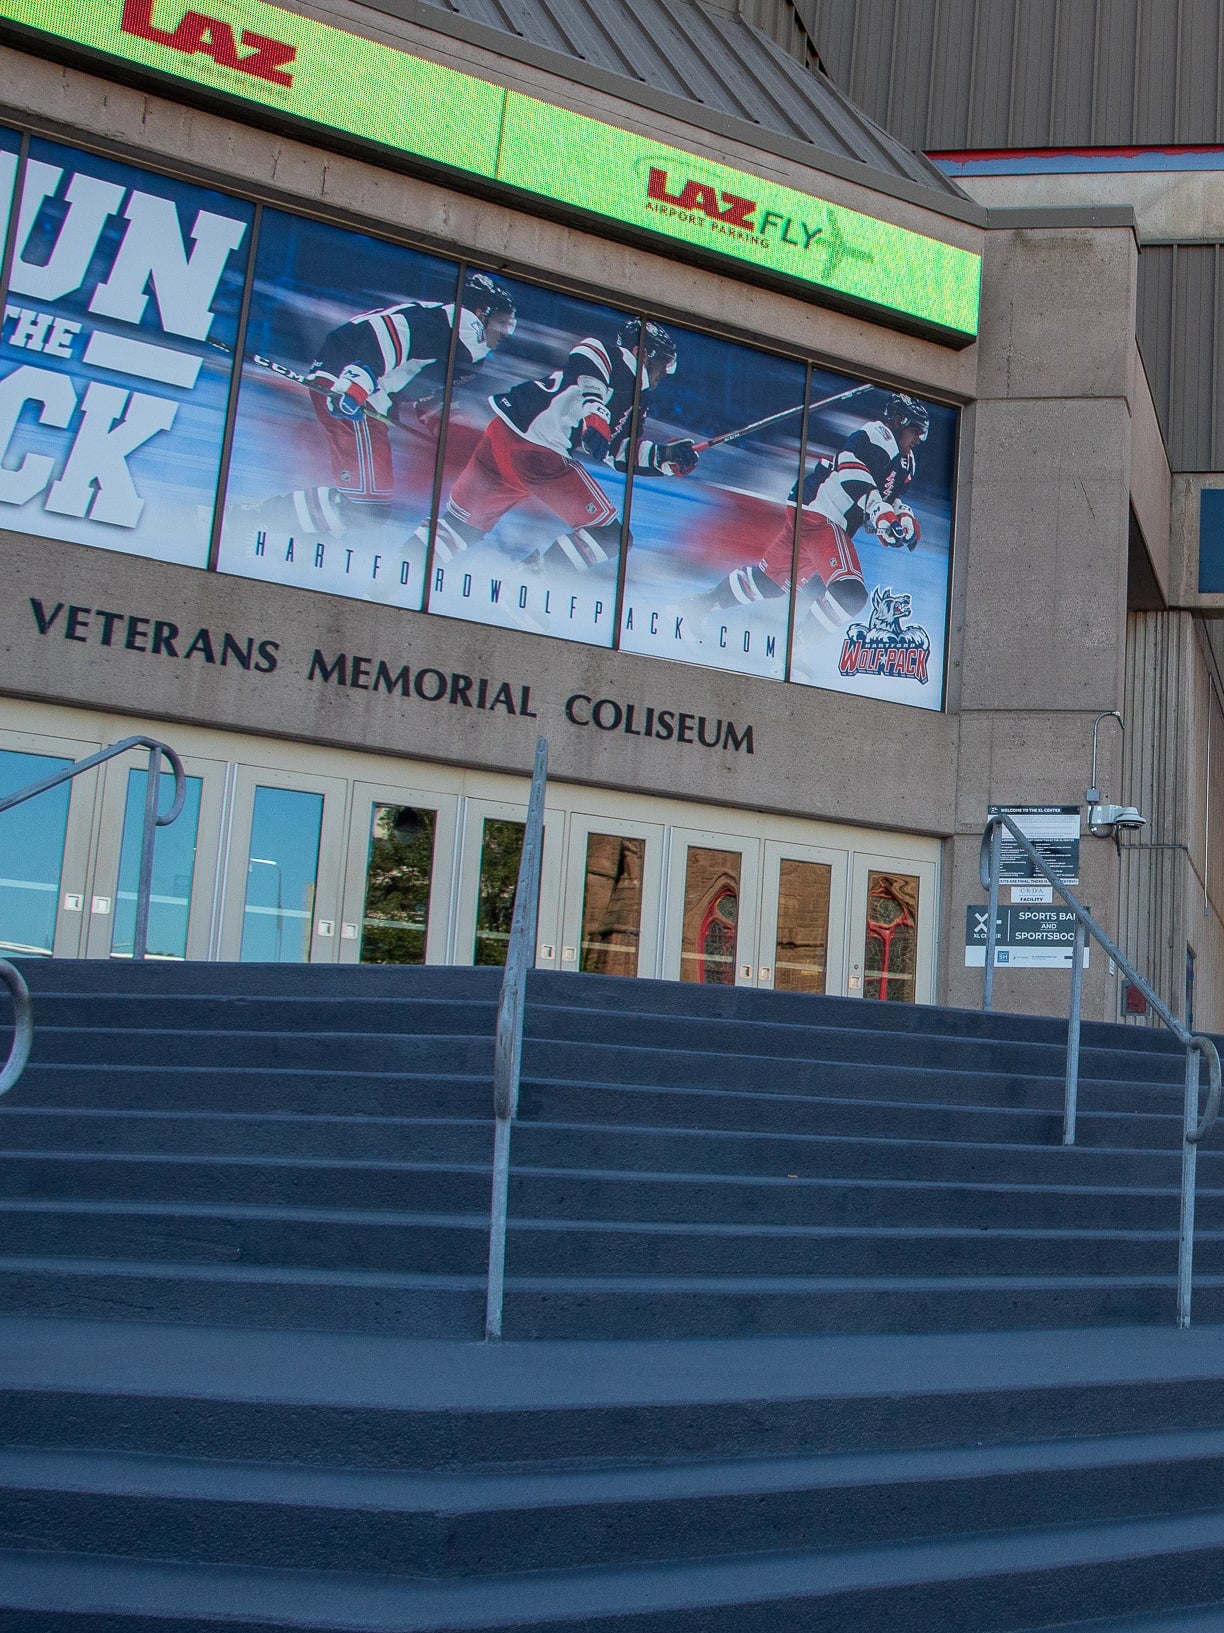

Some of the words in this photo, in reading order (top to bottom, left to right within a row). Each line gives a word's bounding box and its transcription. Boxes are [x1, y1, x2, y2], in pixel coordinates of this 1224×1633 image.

[121, 0, 297, 88] LAZ
[646, 202, 705, 227] AIRPORT
[711, 221, 770, 249] PARKING
[648, 167, 756, 232] LAZ
[760, 210, 822, 249] FLY
[253, 354, 305, 383] CCM
[29, 597, 280, 674] VETERANS
[307, 649, 538, 718] MEMORIAL
[565, 694, 755, 755] COLISEUM
[1015, 932, 1075, 940] SPORTSBOO
[1018, 912, 1057, 920] SPORTS
